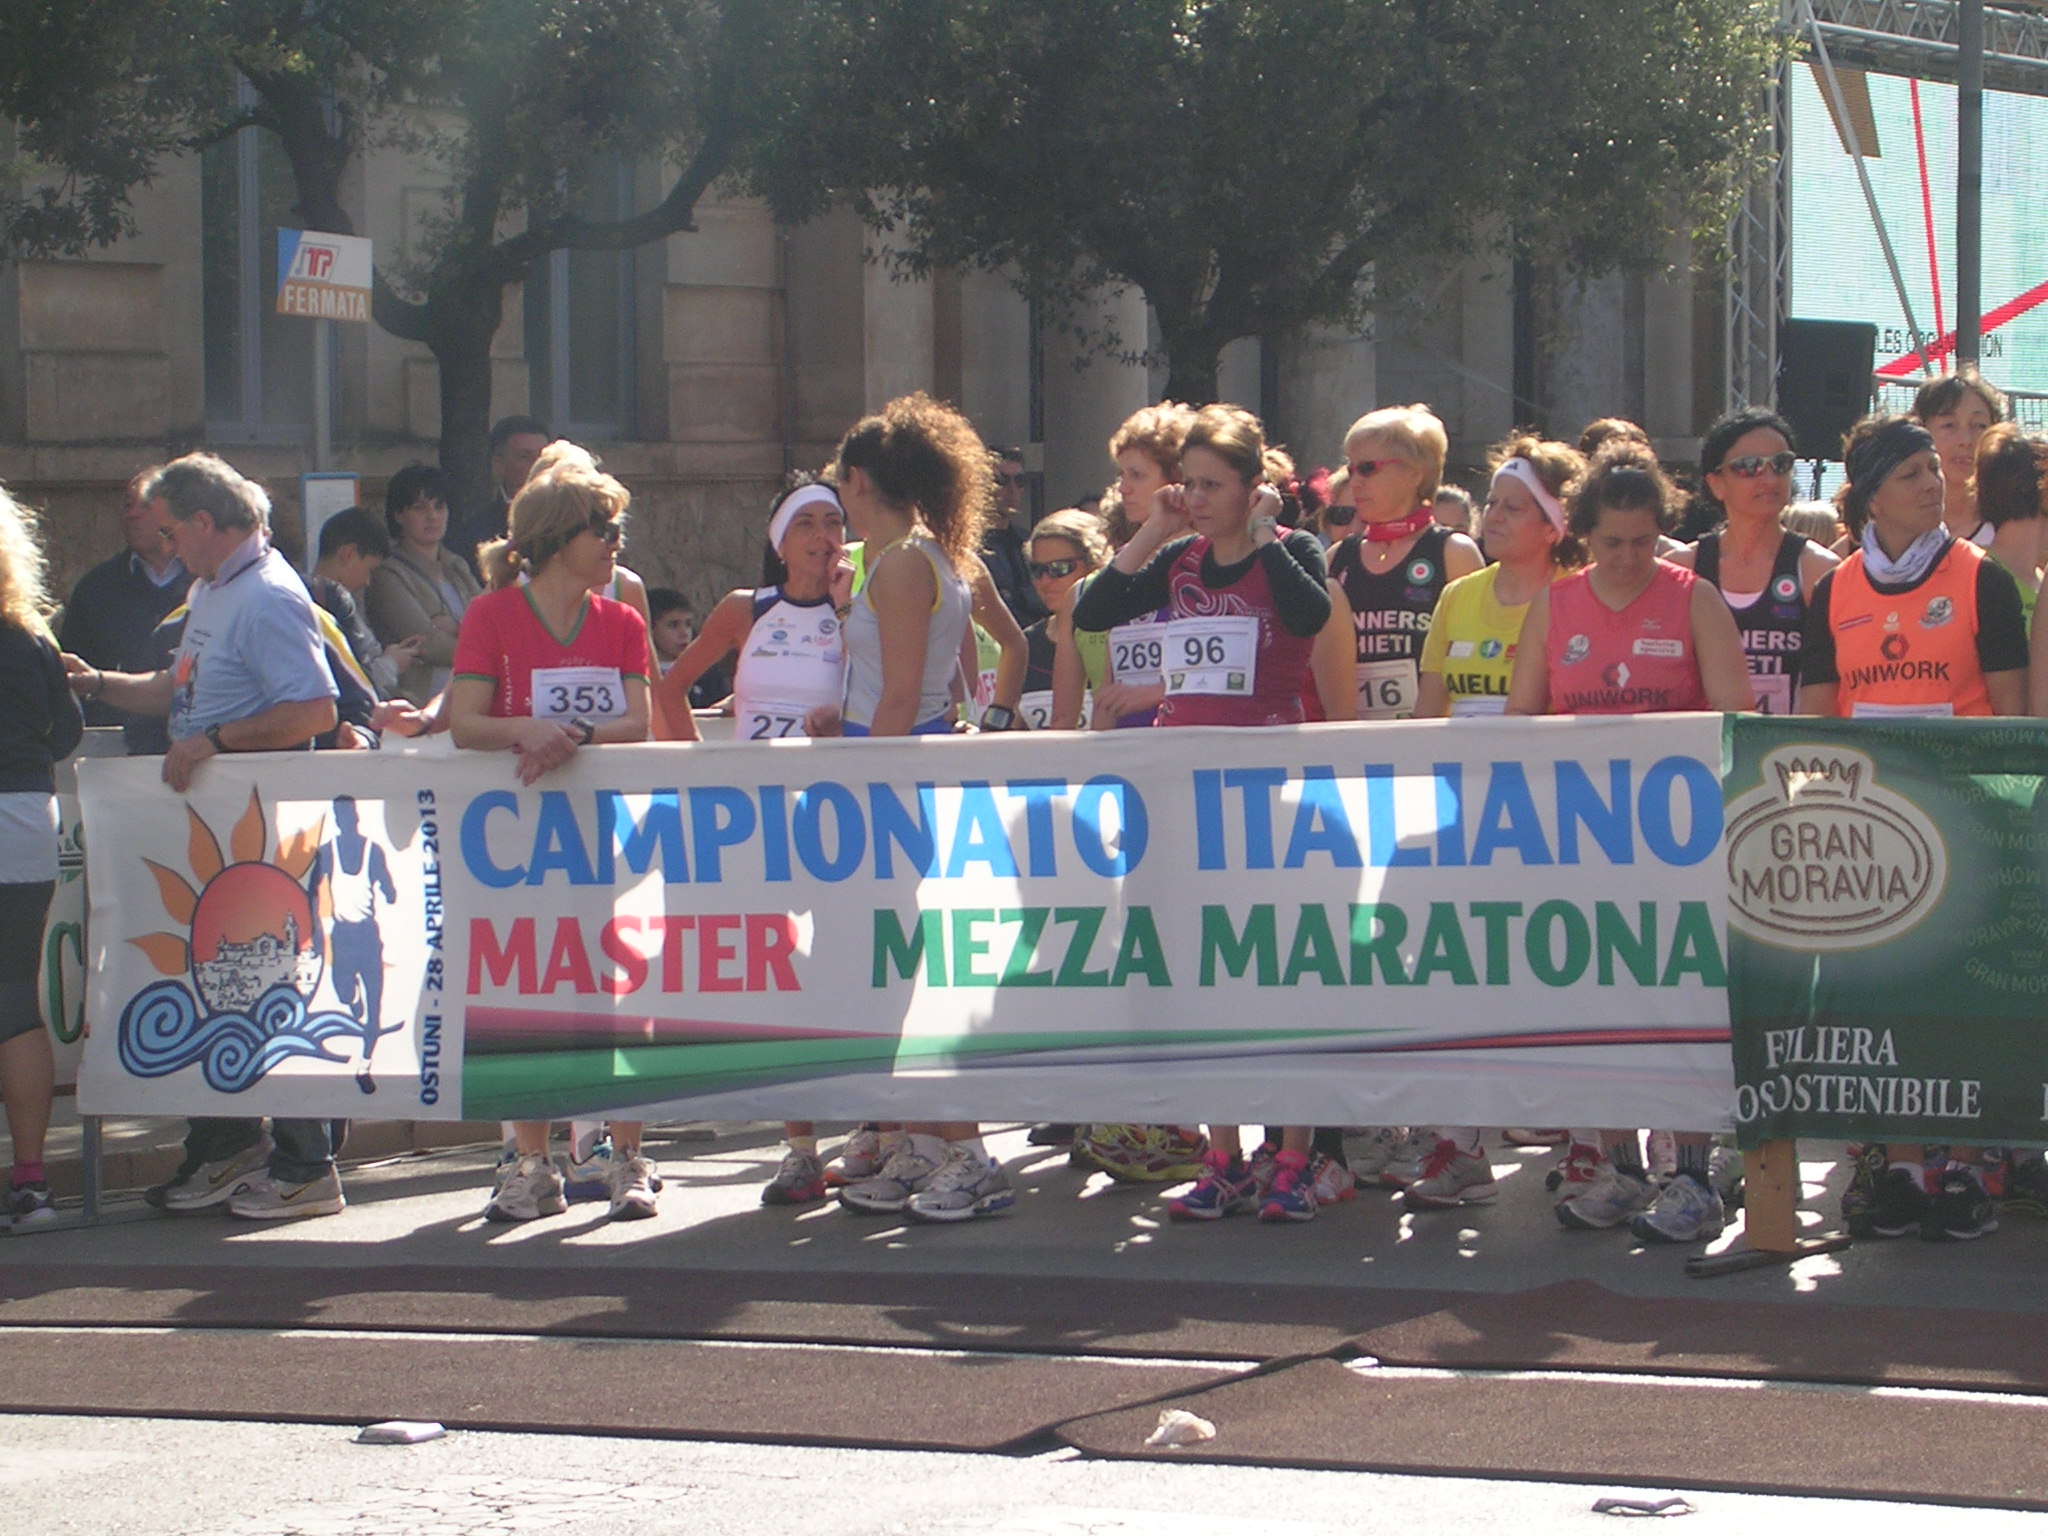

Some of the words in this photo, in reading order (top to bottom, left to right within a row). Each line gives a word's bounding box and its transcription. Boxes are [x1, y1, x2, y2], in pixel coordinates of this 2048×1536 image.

[284, 285, 367, 319] FERMATA
[1116, 641, 1162, 671] 269
[1184, 636, 1225, 666] 96
[1844, 660, 1949, 690] UNIWORK
[549, 686, 614, 713] 353
[1358, 679, 1402, 708] 16
[1565, 687, 1671, 709] UNIWORK
[750, 714, 804, 740] 27
[417, 788, 440, 854] 2013
[460, 774, 1149, 888] CAMPIONATO
[1193, 755, 1724, 870] ITALIANO
[1771, 822, 1875, 862] GRAN
[1742, 864, 1911, 905] MORAVIA
[423, 861, 444, 951] APRILE
[466, 912, 802, 995] MASTER
[872, 905, 1172, 988] MEZZA
[1200, 899, 1728, 988] MARATONA
[427, 957, 443, 992] 28
[420, 1014, 442, 1106] OSTUNI
[1764, 1026, 1899, 1069] FILIERA
